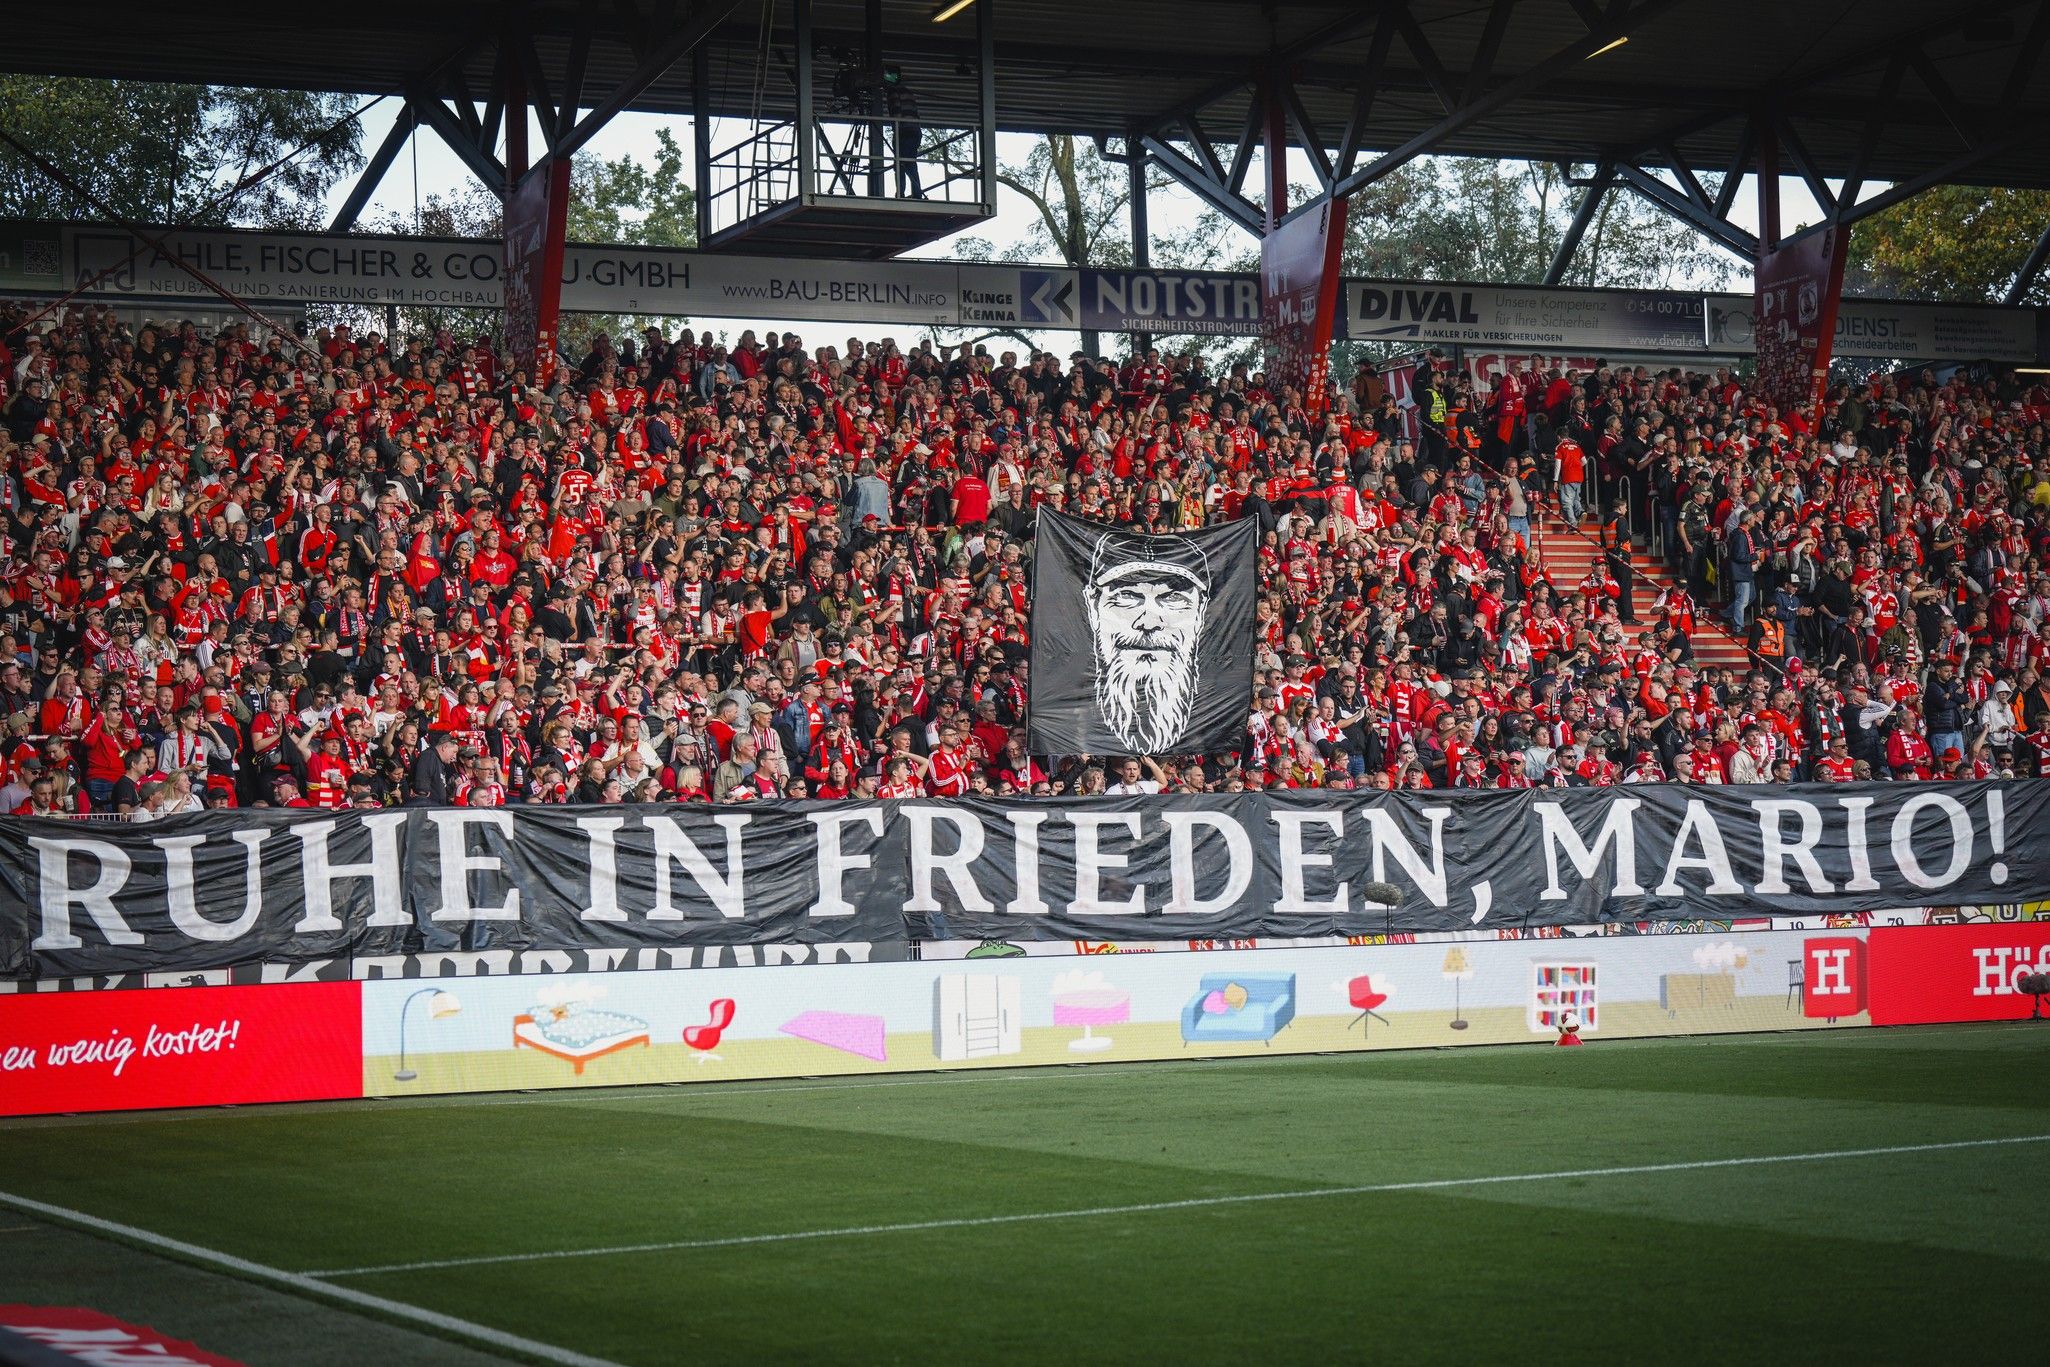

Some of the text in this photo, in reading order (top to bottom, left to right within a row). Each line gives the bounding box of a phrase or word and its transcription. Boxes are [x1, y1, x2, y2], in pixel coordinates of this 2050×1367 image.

[260, 246, 401, 277] FISCHER
[411, 252, 433, 279] &
[444, 253, 503, 281] CO.
[231, 282, 269, 296] UND
[278, 284, 378, 299] SANIERUNG
[386, 289, 404, 300] IM
[412, 290, 497, 304] HOCHBAU
[1097, 274, 1259, 319] NOTSTR
[1359, 289, 1479, 323] DIVAL
[1495, 294, 1607, 312] Unsere Kompetenz
[1495, 311, 1600, 329] für Ihre Sicherheit
[1639, 300, 1702, 315] 54 00 71 0
[1423, 328, 1563, 342] MAKLER FÜR VERSICHERUNGEN
[1628, 333, 1703, 347] www.dival.de
[28, 789, 2009, 950] RUHE IN FRIEDEN, MARIO!
[1811, 948, 1851, 995] H
[0, 1019, 240, 1076] en wenig kostet!
